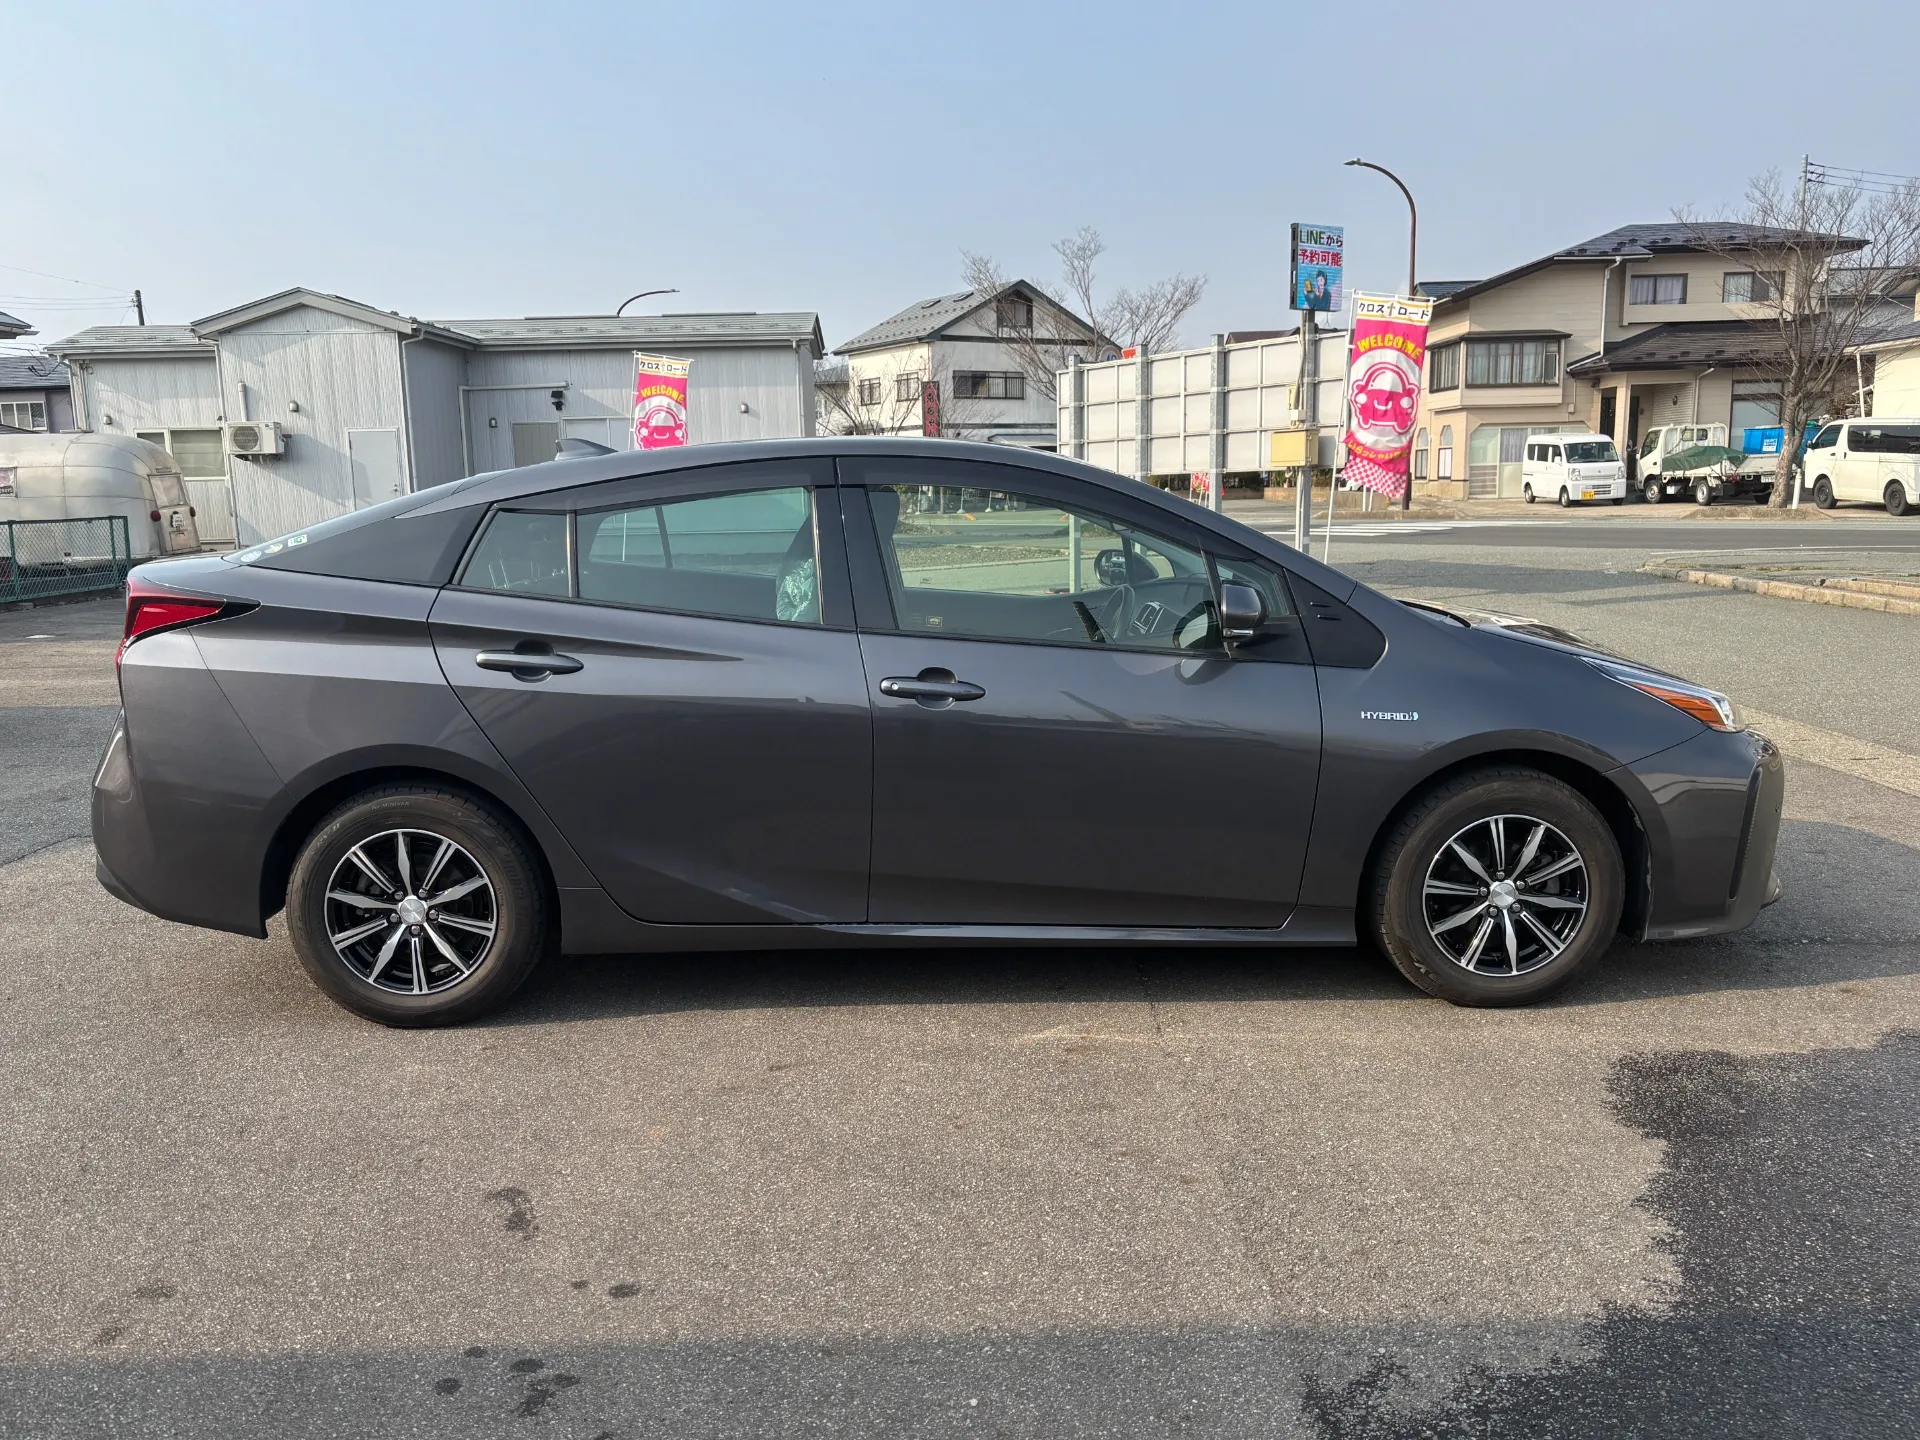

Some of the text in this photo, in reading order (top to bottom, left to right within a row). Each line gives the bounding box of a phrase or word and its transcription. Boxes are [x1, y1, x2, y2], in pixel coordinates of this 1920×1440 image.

[1300, 229, 1343, 248] LINEから
[1299, 248, 1343, 267] 予約可能
[1357, 333, 1423, 359] WELCOME
[641, 384, 685, 403] WELCOME
[1361, 710, 1410, 721] HYBRID
